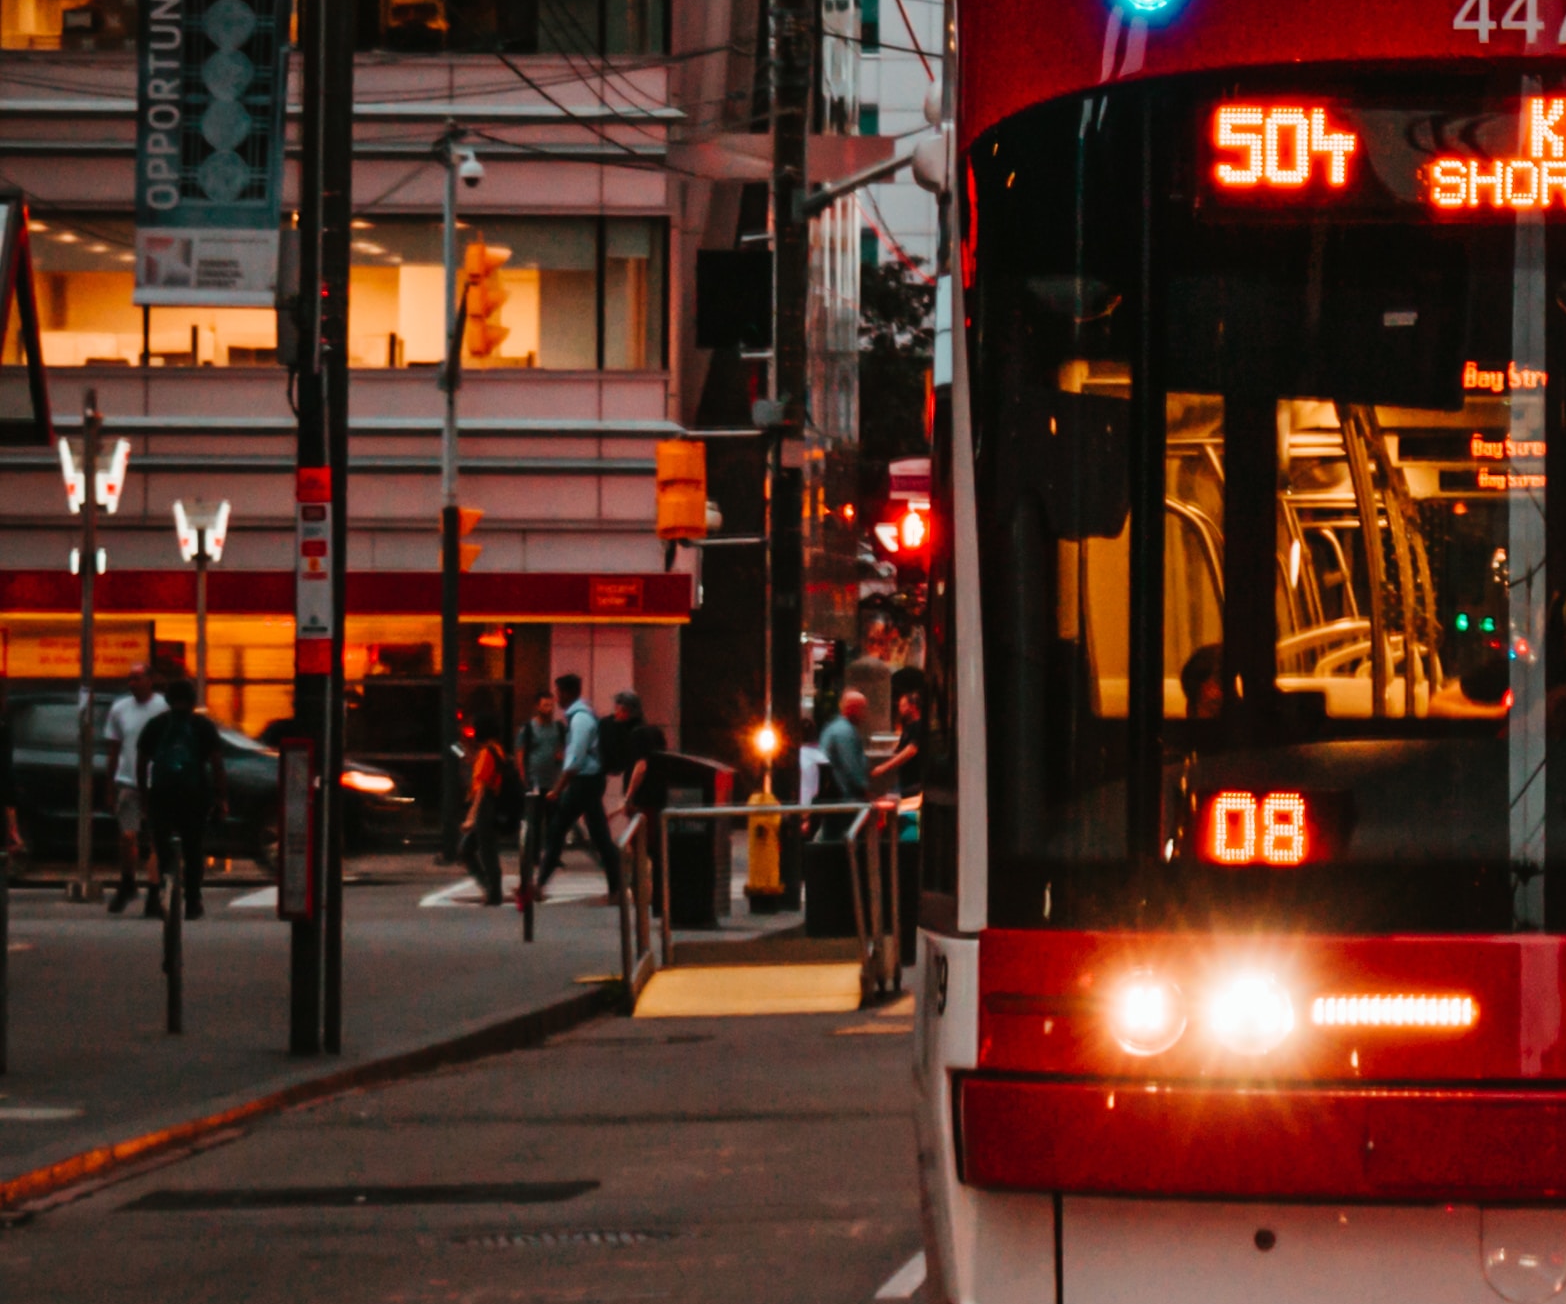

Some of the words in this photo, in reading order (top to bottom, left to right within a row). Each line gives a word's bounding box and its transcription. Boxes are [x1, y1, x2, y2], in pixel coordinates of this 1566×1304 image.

[1216, 107, 1357, 187] 504
[1463, 361, 1504, 392] Bay
[1214, 792, 1306, 862] 08
